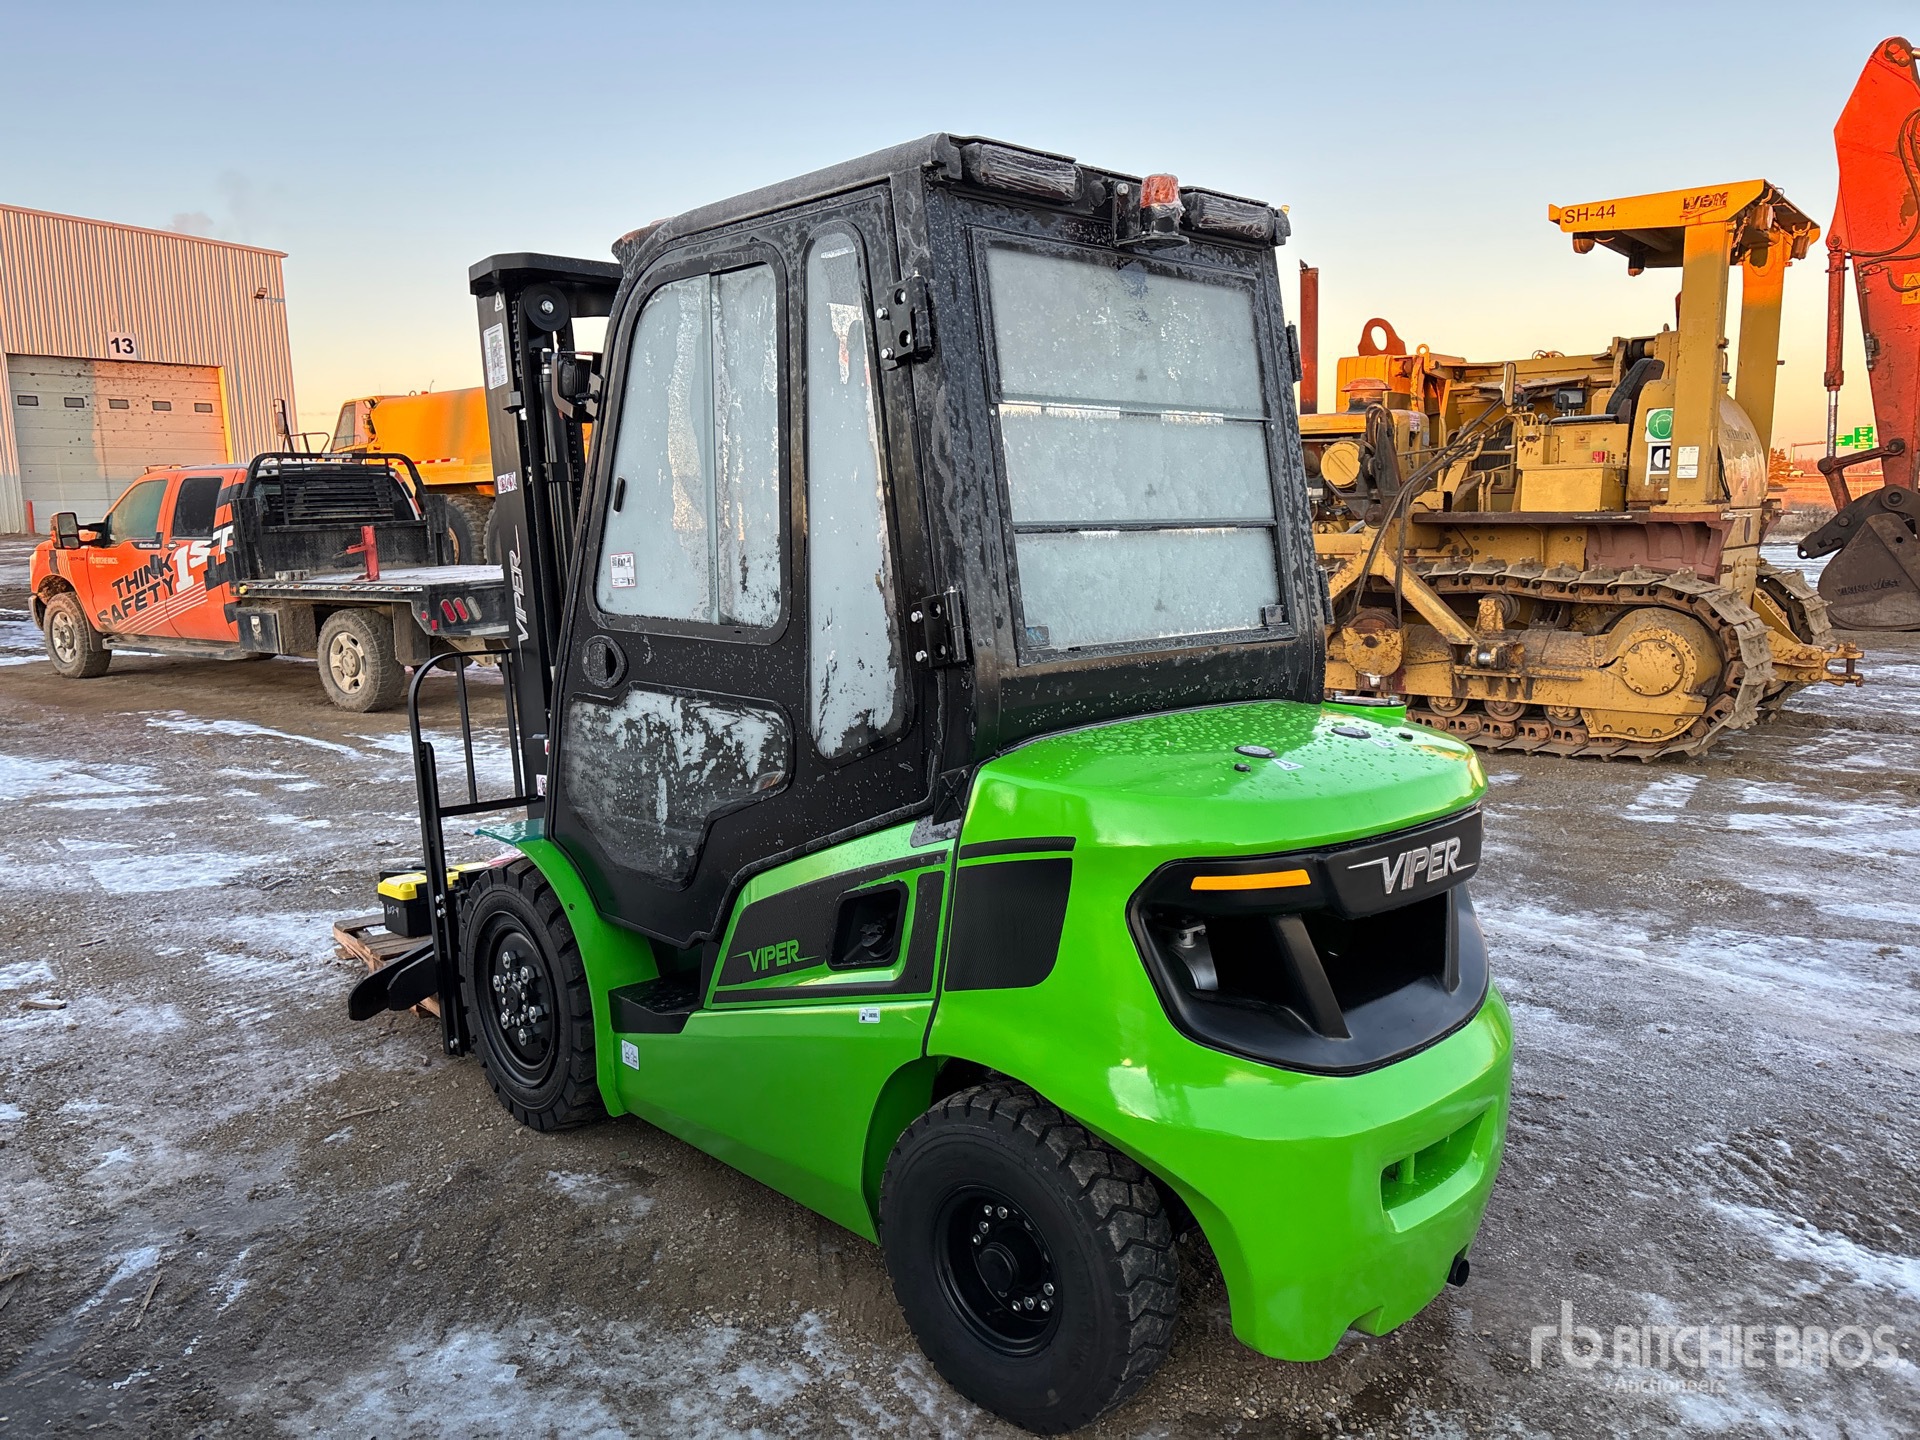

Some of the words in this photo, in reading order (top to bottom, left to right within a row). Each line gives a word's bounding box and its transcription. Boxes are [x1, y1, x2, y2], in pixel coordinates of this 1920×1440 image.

[1564, 204, 1616, 224] SH-44
[110, 337, 135, 355] 13
[111, 552, 173, 599] THINK
[173, 525, 234, 593] 1ST
[97, 574, 174, 626] SAFETY
[509, 531, 529, 661] VIPER
[1351, 836, 1474, 894] VIPER
[735, 940, 815, 972] VIPER
